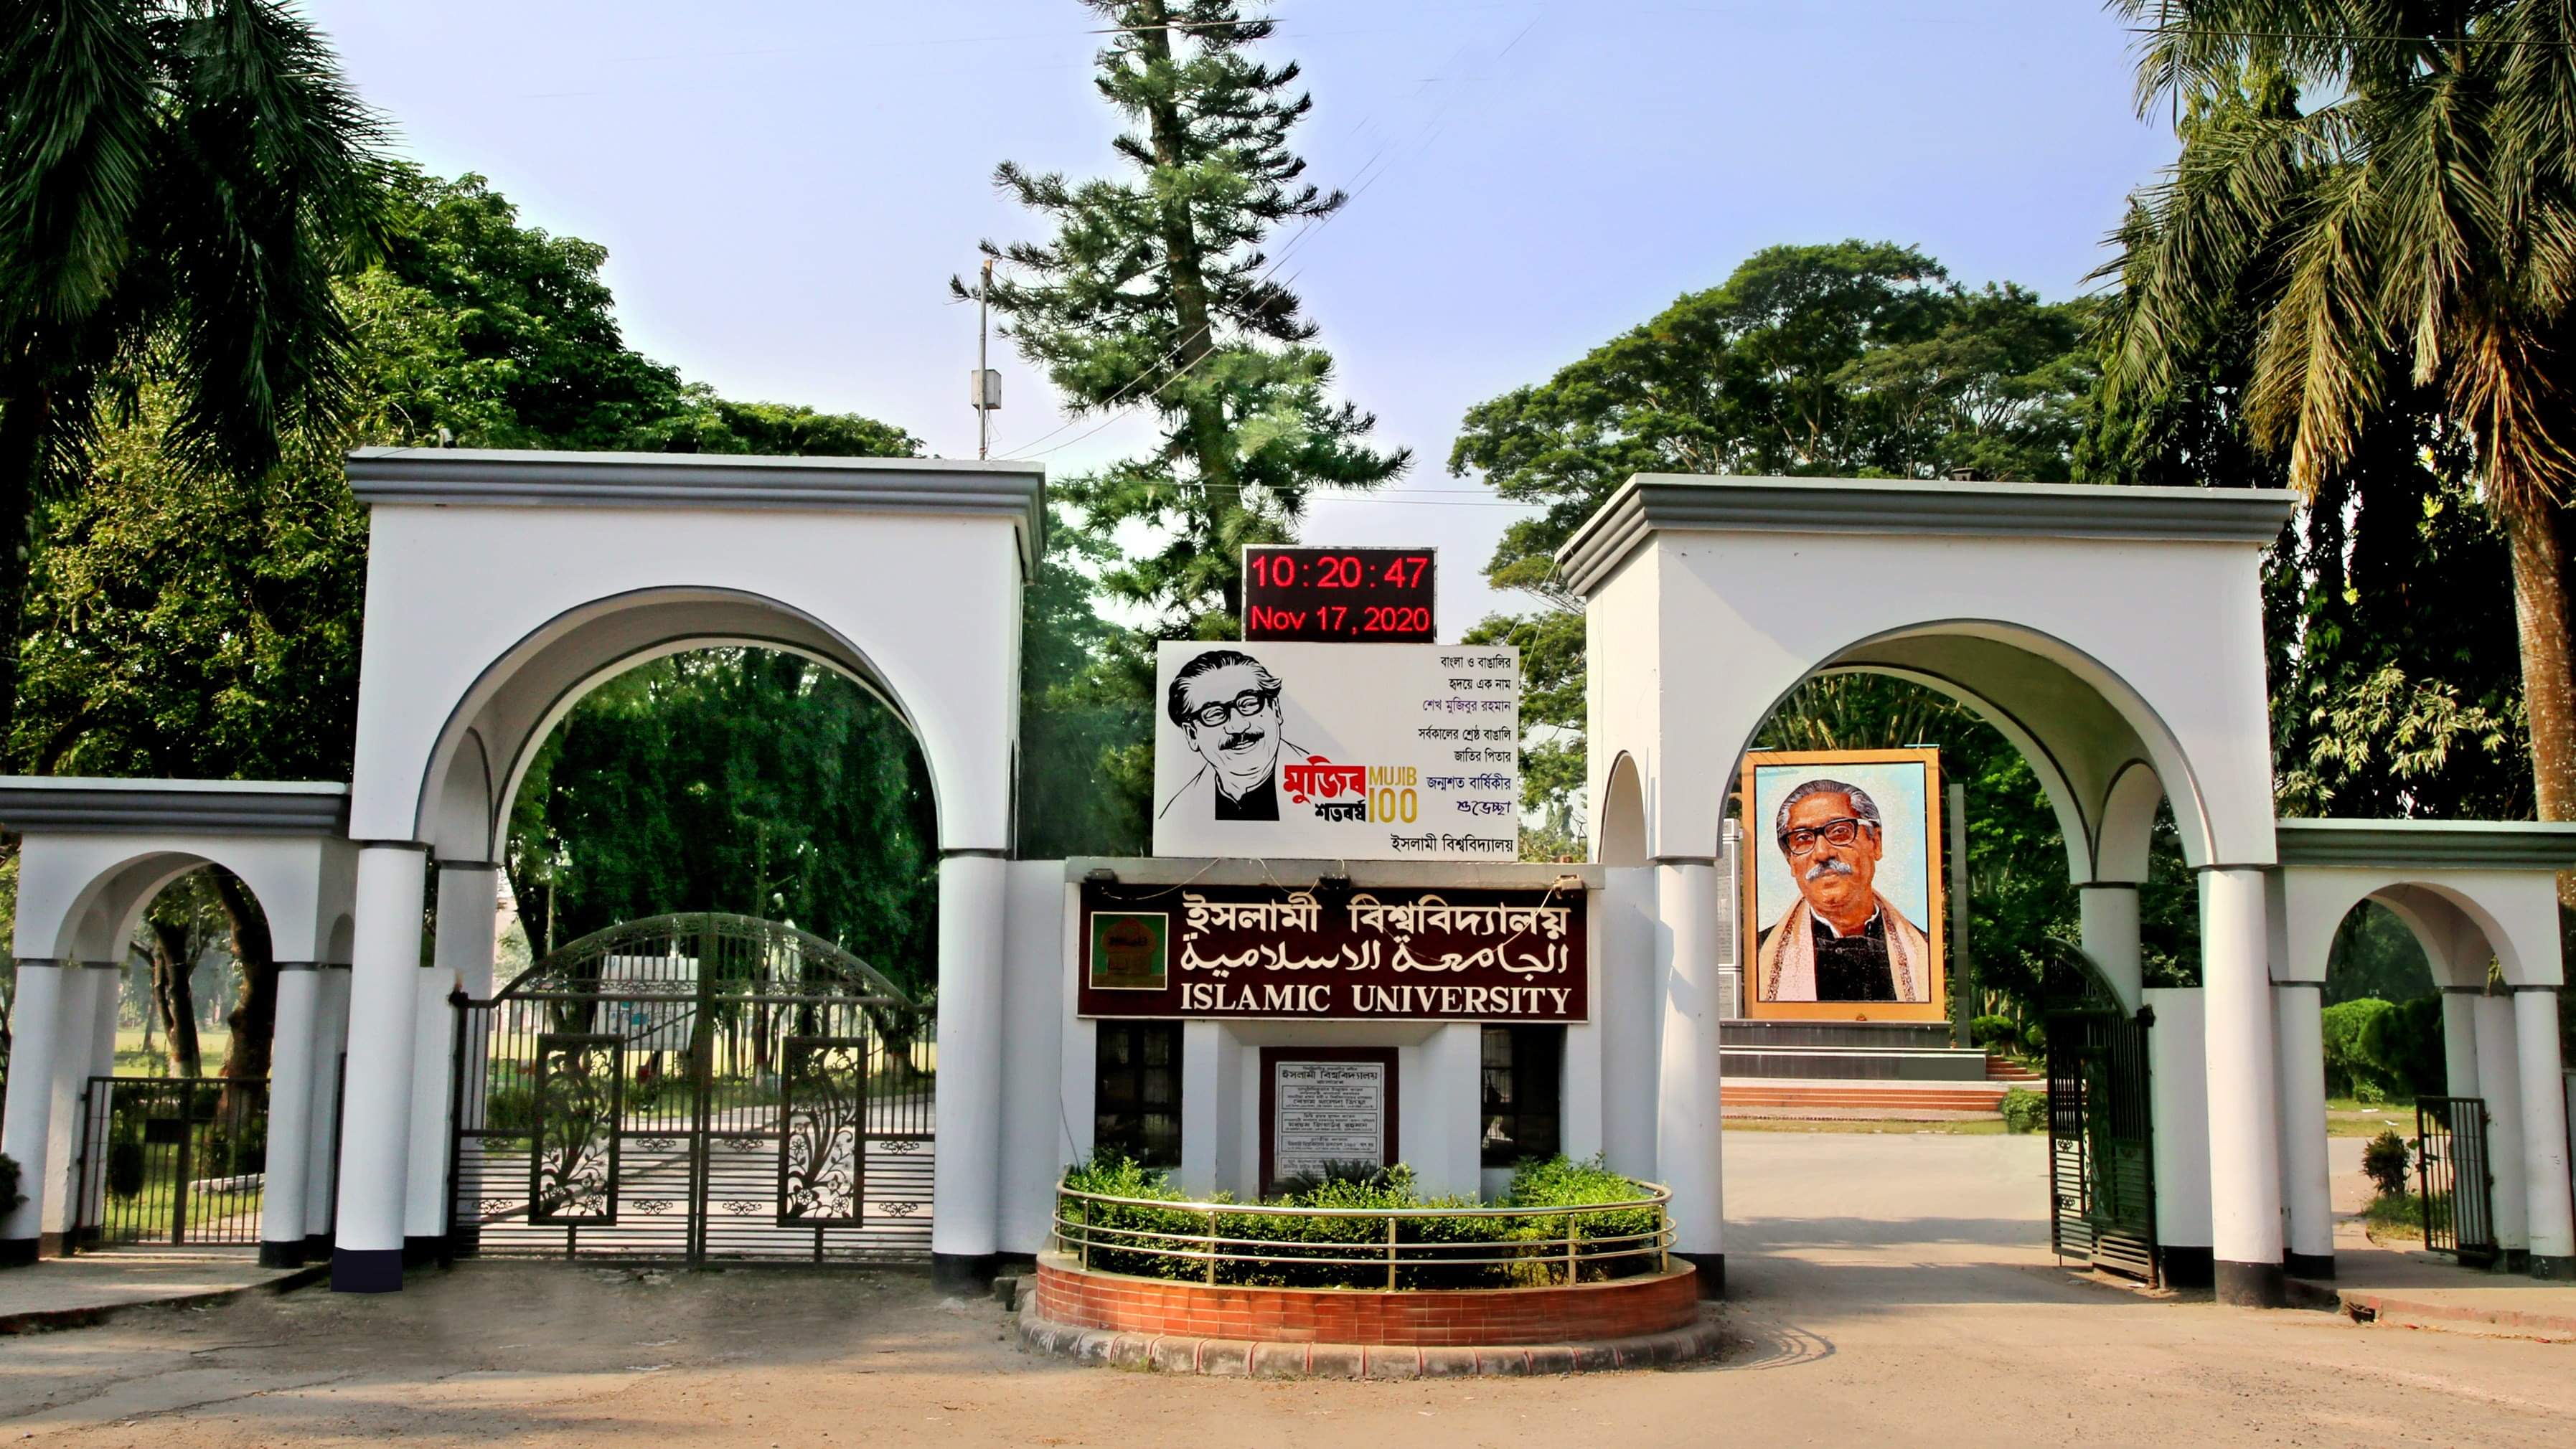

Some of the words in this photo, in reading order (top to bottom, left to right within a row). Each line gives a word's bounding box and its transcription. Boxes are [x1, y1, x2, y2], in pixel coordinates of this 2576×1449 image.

[1251, 605, 1307, 630] Nov
[1363, 607, 1429, 631] 2020
[1441, 656, 1463, 669] বাংলা
[1467, 658, 1475, 668] ও
[1477, 654, 1511, 669] বাঙালির
[1449, 678, 1472, 691] হৃদয়ে
[1477, 679, 1493, 689] এক
[1495, 679, 1511, 690] নাম
[1423, 699, 1442, 711] শেখ
[1446, 697, 1477, 714] মুজিবুর
[1481, 700, 1511, 712] রহমান
[1418, 724, 1458, 740] সর্বকালের
[1462, 724, 1480, 742] শ্রেষ্ঠ
[1484, 726, 1511, 741] বাঙালি
[1454, 747, 1481, 763] জাতির
[1485, 747, 1511, 763] পিতার
[1283, 755, 1366, 804] মুজিব
[1369, 766, 1417, 786] MUJIB
[1426, 776, 1465, 791] জন্মশত
[1469, 773, 1511, 790] বার্ষিকীর
[1315, 799, 1366, 822] শতবর্ষ
[1369, 788, 1418, 823] 100
[1457, 801, 1512, 816] শুভেচ্ছা
[1391, 833, 1437, 852] ইসলামী
[1442, 834, 1513, 853] বিশ্ববিদ্যালয়
[1183, 890, 1322, 934] ইসলামী
[1346, 893, 1571, 940] বিশ্ববিদ্যালয়
[1392, 935, 1569, 981] الجامعة
[1180, 983, 1330, 1011] ISLAMIC
[1351, 985, 1572, 1014] UNIVERSITY
